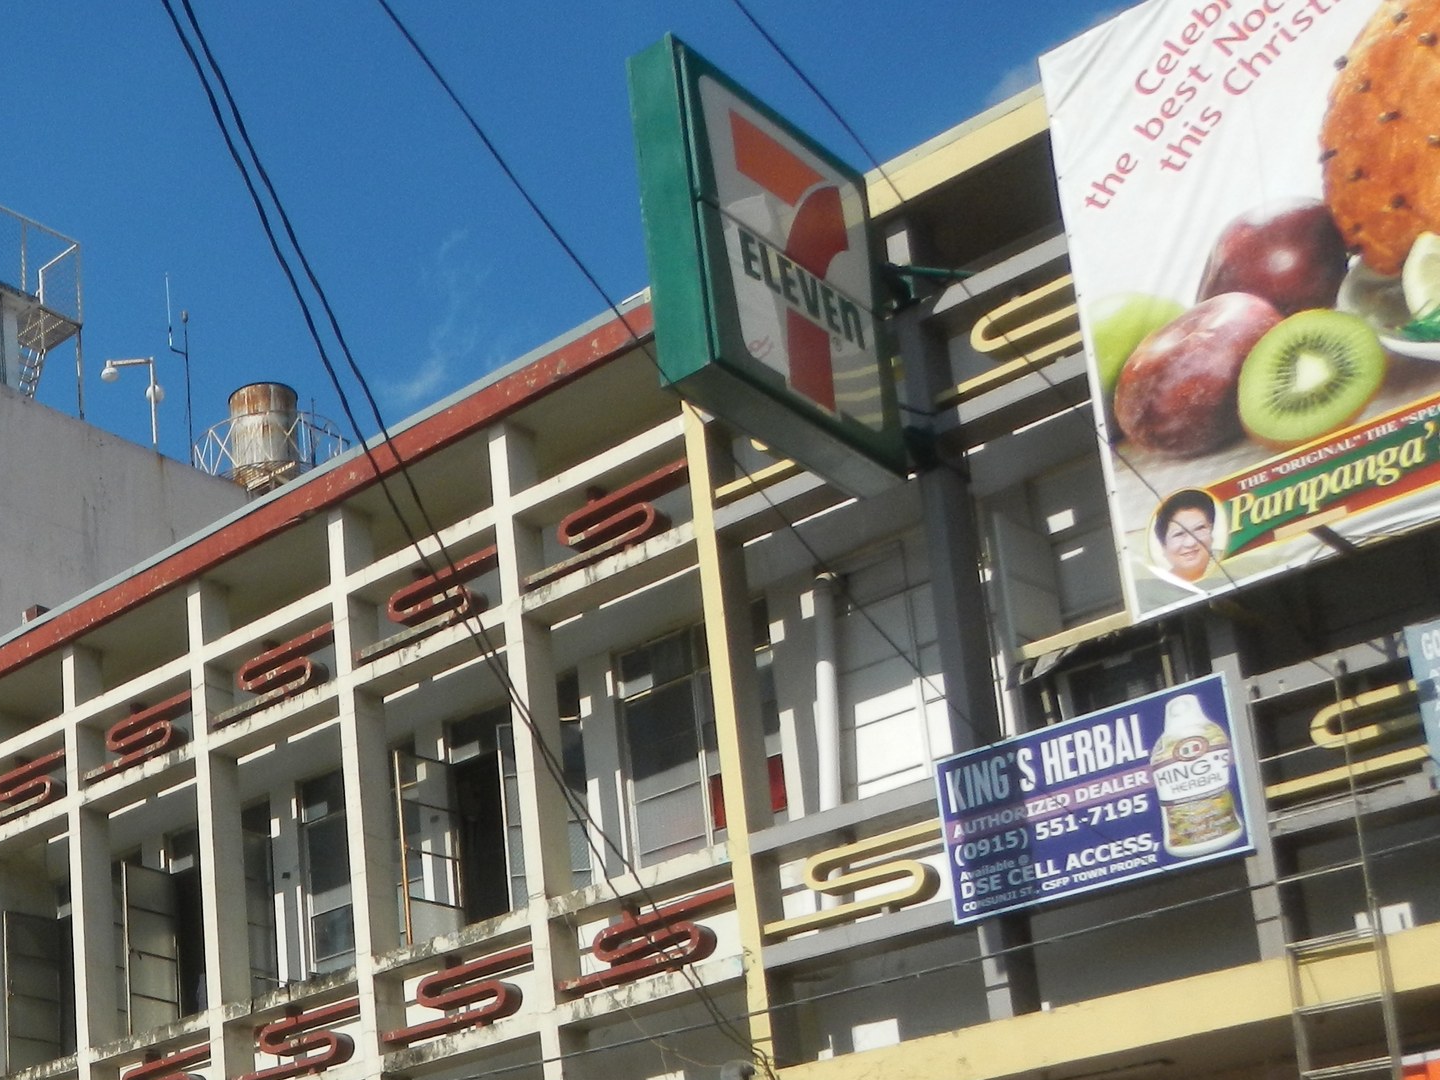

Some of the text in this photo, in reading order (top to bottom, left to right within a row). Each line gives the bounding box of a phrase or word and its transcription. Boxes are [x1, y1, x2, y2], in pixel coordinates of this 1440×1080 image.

[1134, 0, 1232, 96] Celeb
[1160, 0, 1344, 173] this Christ
[1085, 152, 1139, 210] the
[1134, 64, 1212, 142] best
[1228, 420, 1440, 534] Pampanga'
[1237, 470, 1270, 491] THE
[1366, 419, 1398, 441] THE
[1400, 402, 1440, 425] "SPE
[945, 714, 1149, 814] KING'S HERBAL
[954, 770, 1150, 839] AUTHORIZED DEALER
[1169, 773, 1222, 795] HERBAL
[954, 794, 1150, 867] (0915) 551-7195
[960, 858, 1015, 883] Available
[961, 833, 1160, 900] DSE CELL ACCESS,
[1073, 866, 1107, 883] TOWN
[1109, 854, 1158, 874] PROPER
